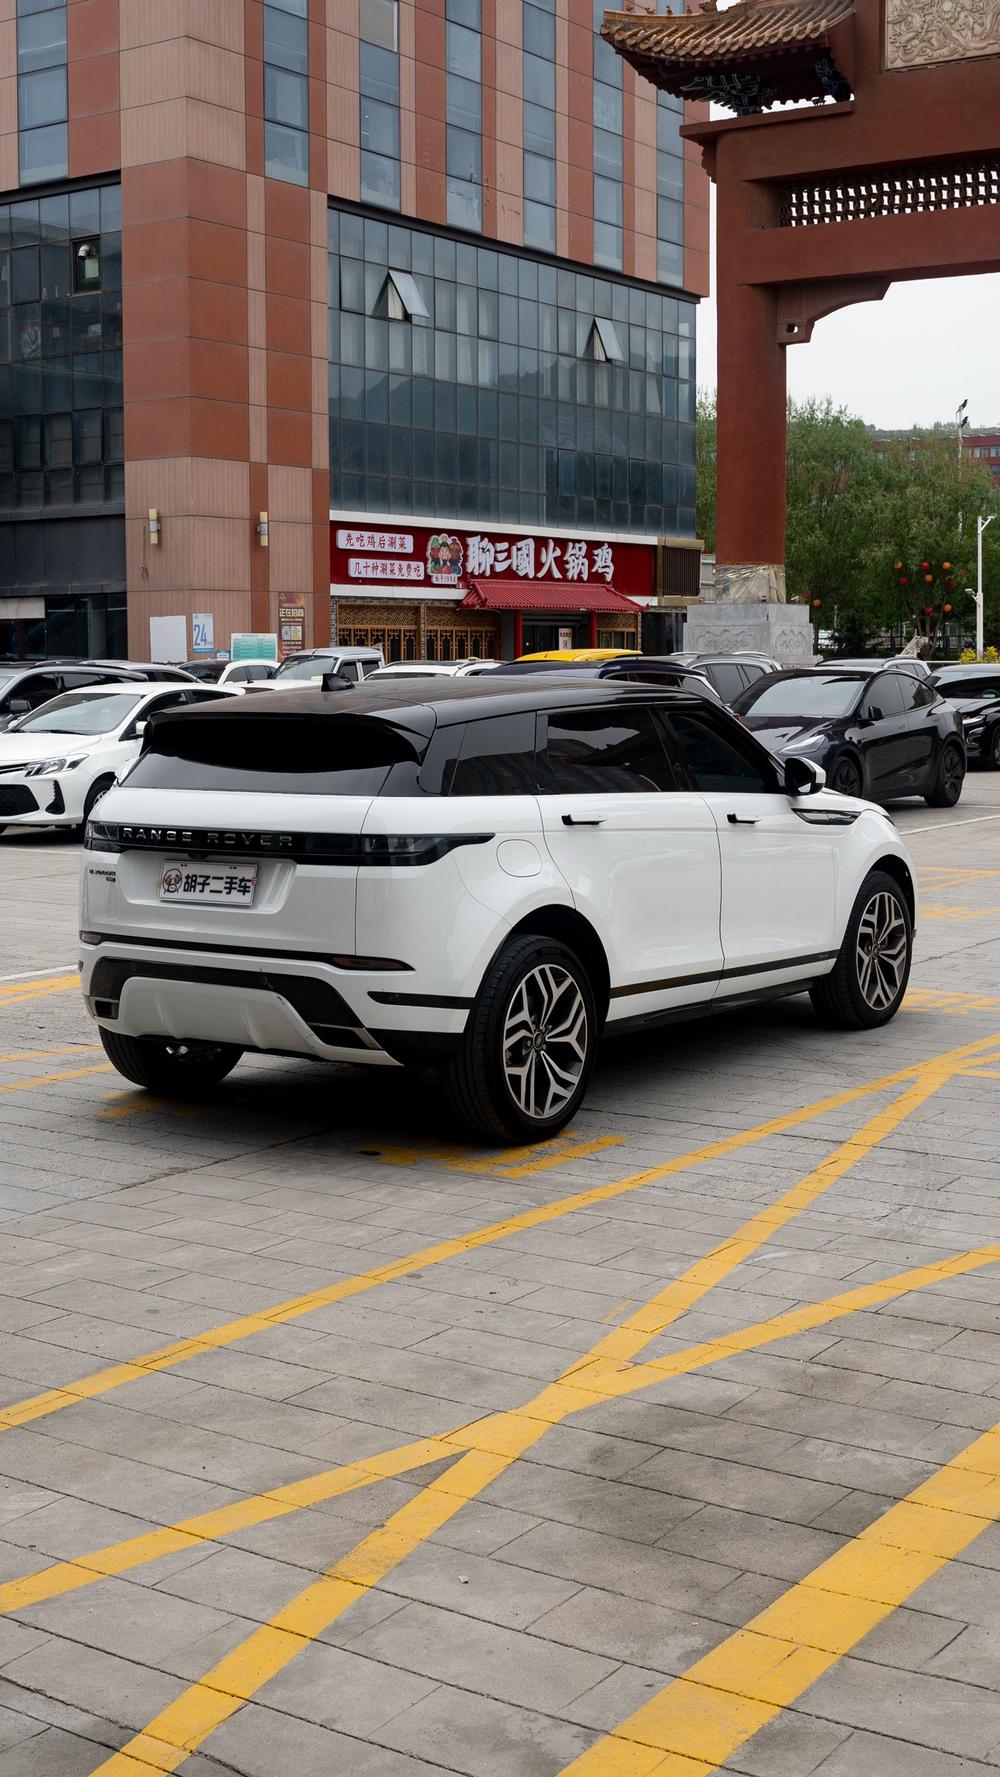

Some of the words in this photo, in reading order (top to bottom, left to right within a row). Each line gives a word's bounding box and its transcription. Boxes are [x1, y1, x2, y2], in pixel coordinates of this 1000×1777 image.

[345, 532, 407, 550] 先吃鸡后涮菜
[354, 562, 422, 578] 几十种涮菜免费吃
[122, 827, 192, 841] RANGE
[207, 832, 293, 847] ROVER
[183, 873, 251, 896] 胡子二手车
